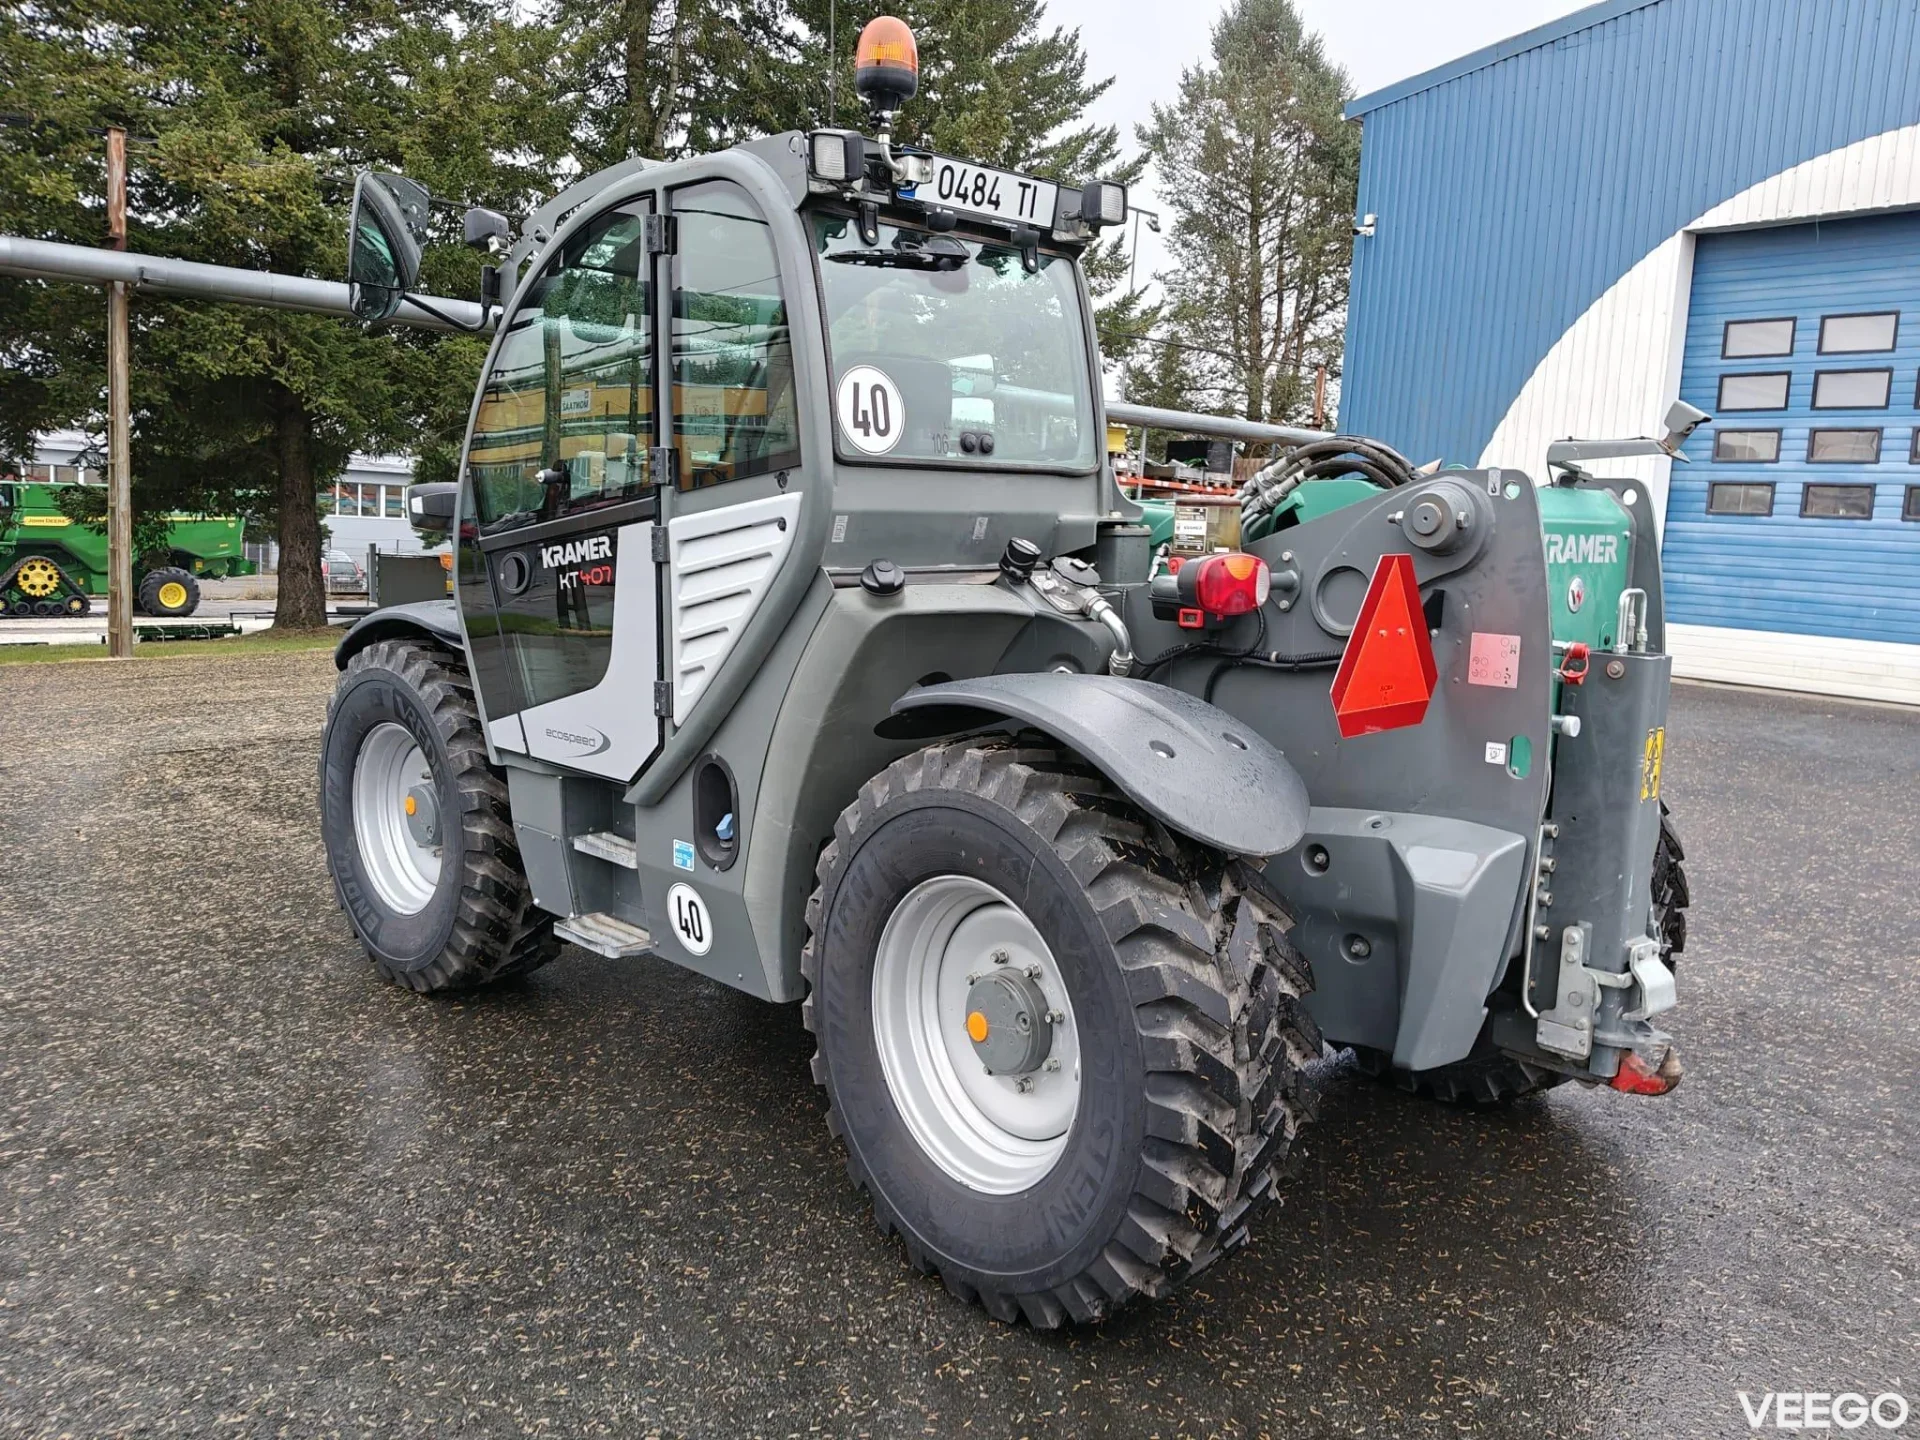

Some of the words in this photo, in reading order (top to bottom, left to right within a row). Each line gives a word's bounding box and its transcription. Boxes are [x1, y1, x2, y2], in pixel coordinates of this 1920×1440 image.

[938, 165, 1001, 211] 0484
[1018, 181, 1037, 218] TI
[852, 382, 891, 437] 40
[541, 536, 613, 569] KRAMER
[545, 728, 596, 748] ecospeed
[677, 895, 704, 943] 40
